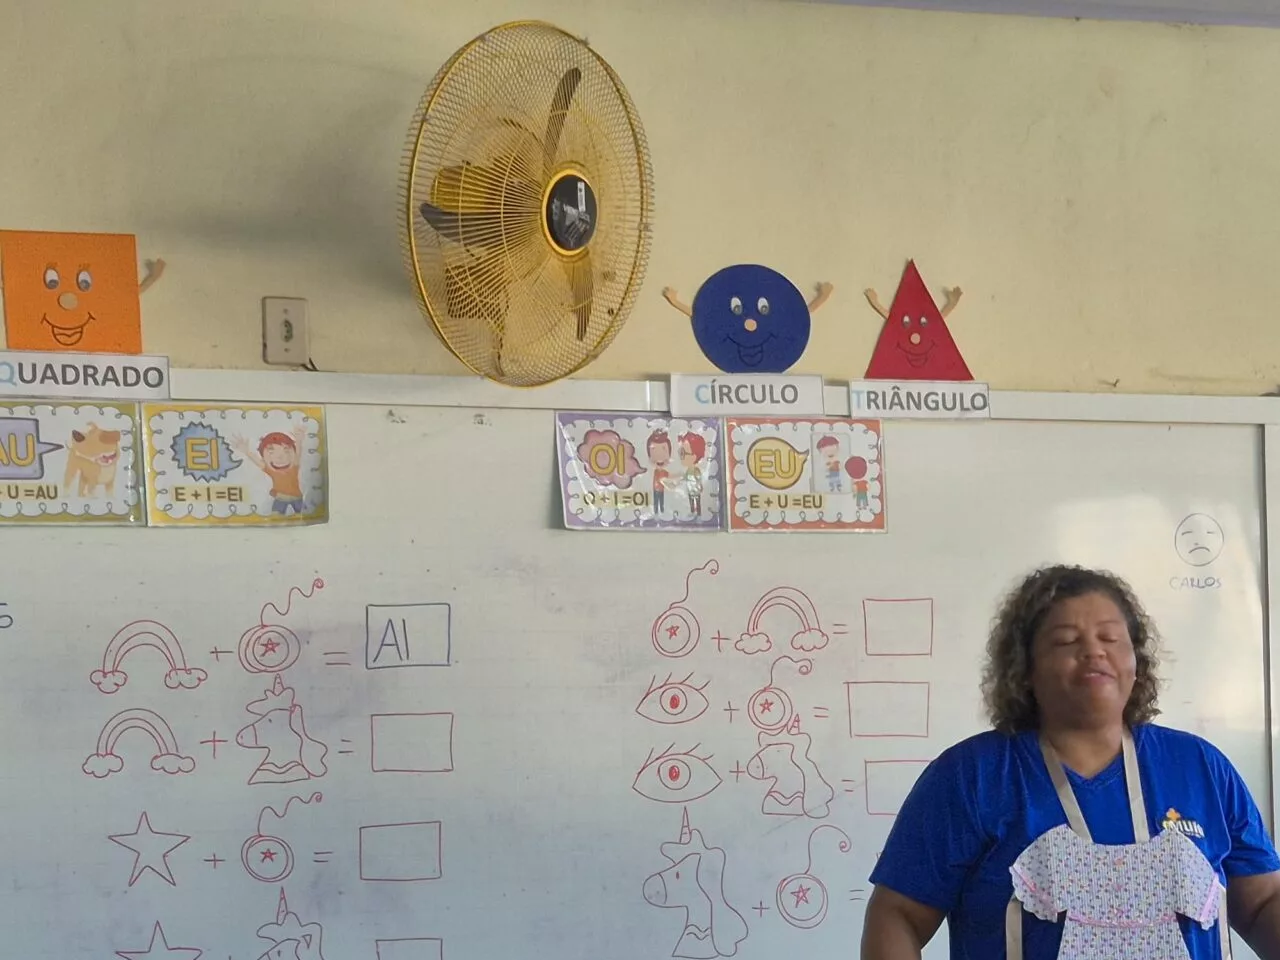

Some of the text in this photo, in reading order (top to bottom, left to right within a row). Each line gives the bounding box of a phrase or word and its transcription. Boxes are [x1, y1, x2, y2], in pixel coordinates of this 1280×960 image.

[0, 361, 164, 389] QUADRADO
[694, 379, 799, 406] CÍRCULO
[851, 383, 988, 412] TRIÂNGULO
[185, 437, 220, 472] EI
[590, 443, 626, 475] OI
[754, 448, 798, 480] EU
[175, 487, 186, 501] E
[749, 495, 759, 509] E
[778, 496, 788, 509] U
[373, 618, 410, 663] AI
